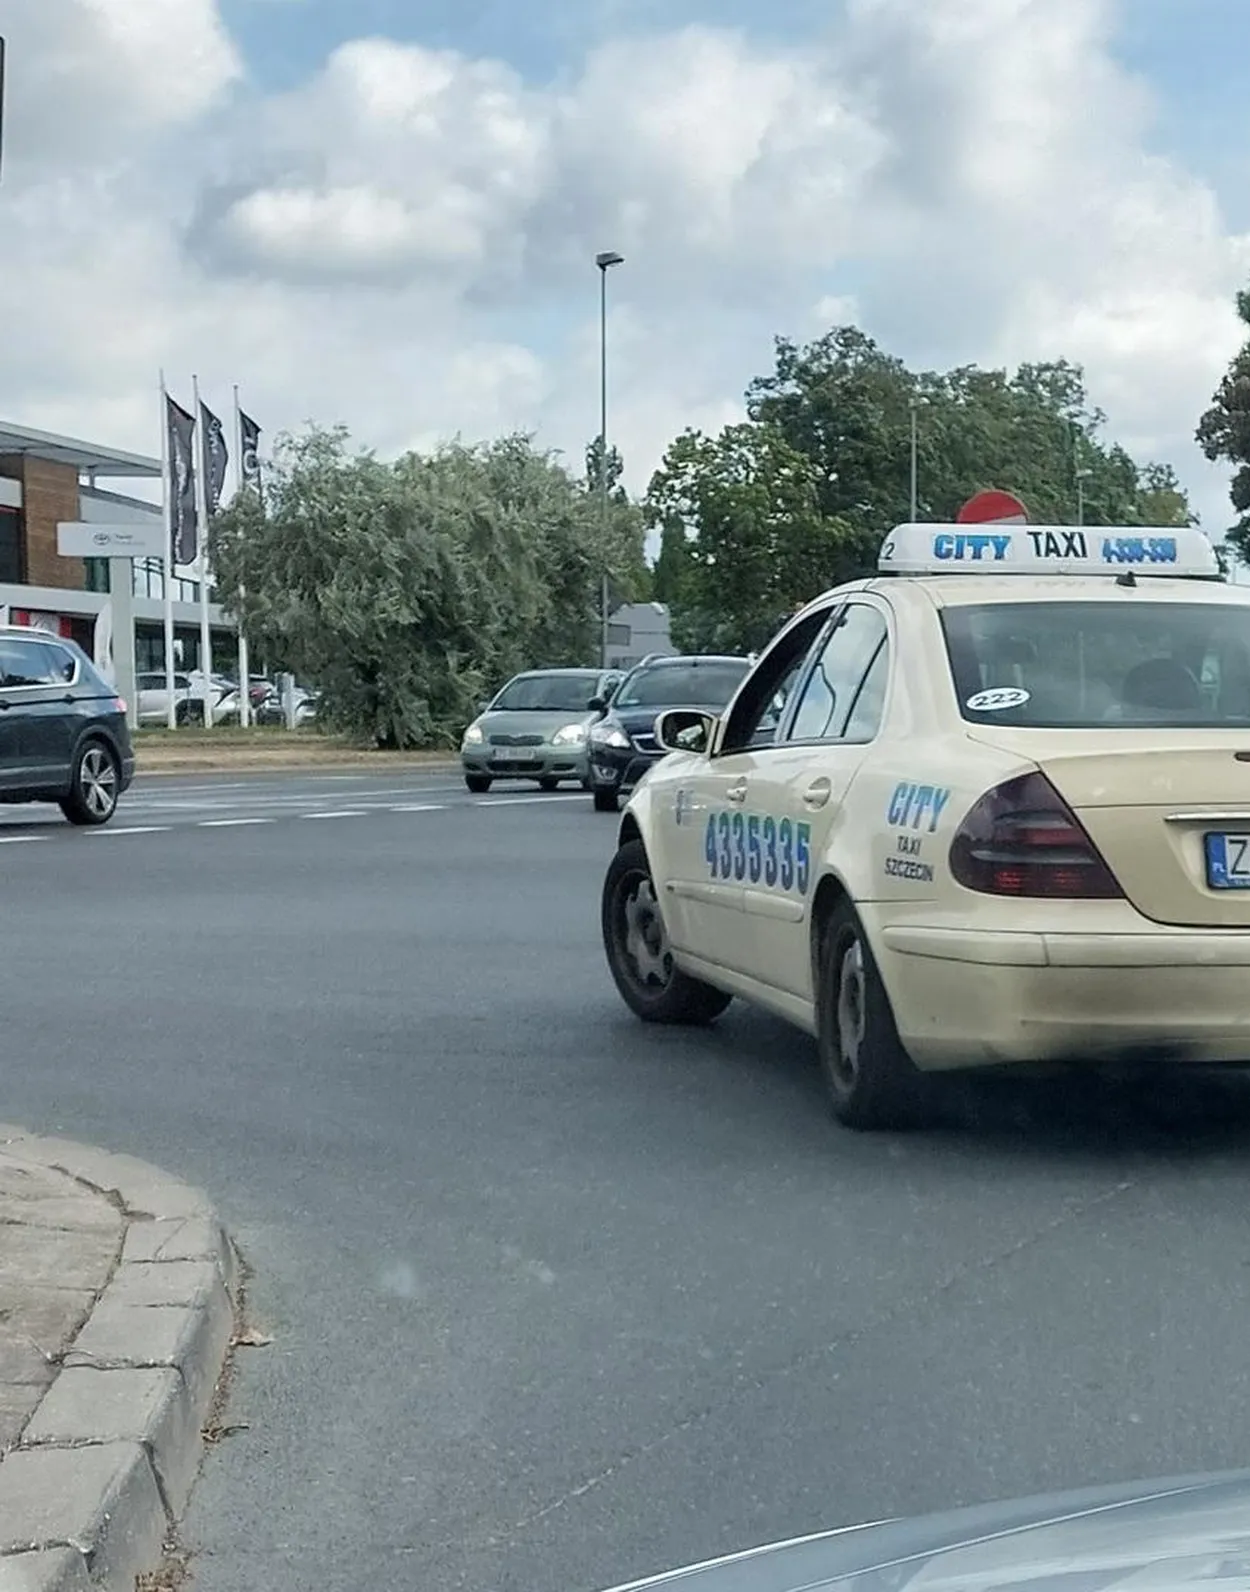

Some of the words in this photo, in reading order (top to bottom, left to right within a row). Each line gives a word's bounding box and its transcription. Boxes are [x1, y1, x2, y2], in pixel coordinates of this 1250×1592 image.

[932, 534, 1012, 560] CITY
[1027, 531, 1088, 558] TAXI
[974, 692, 1021, 706] 222
[888, 782, 949, 833] CITY
[706, 812, 811, 896] 4335335
[897, 836, 921, 856] TAXI
[884, 857, 935, 882] SZCZECIN
